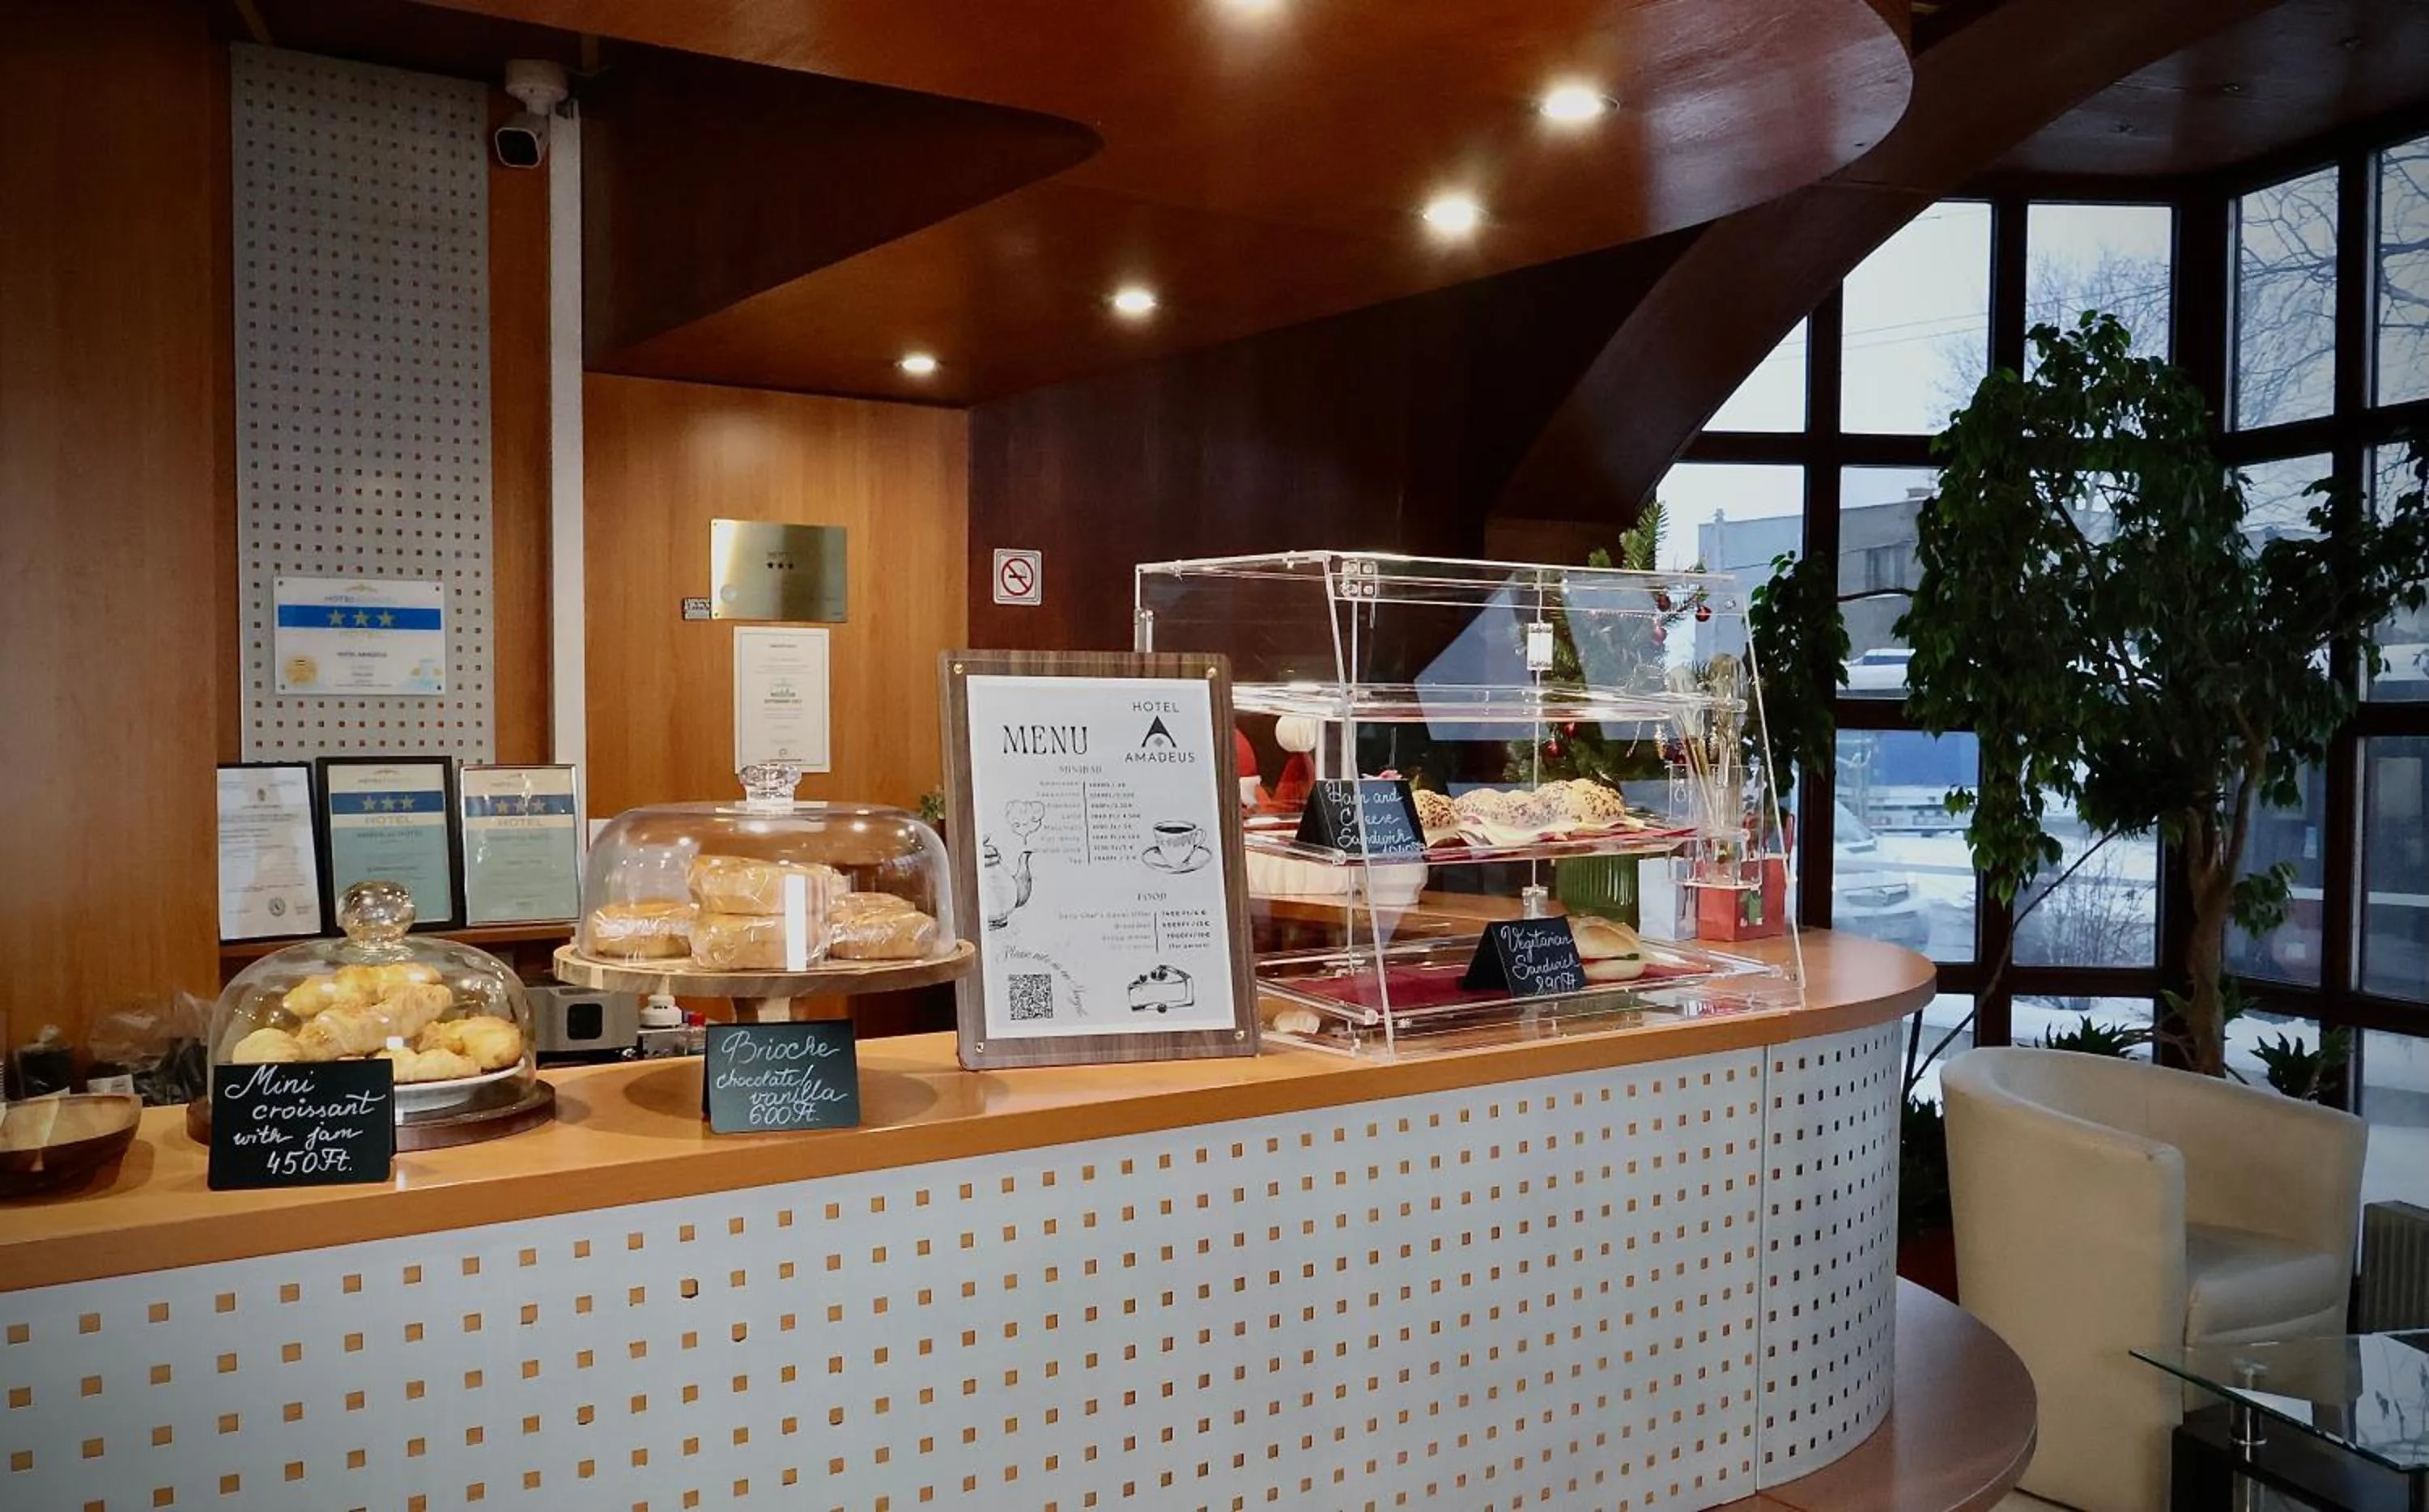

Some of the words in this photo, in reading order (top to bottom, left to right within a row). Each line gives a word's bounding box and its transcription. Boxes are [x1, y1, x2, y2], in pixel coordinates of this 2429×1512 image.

[1133, 702, 1180, 713] HOTEL
[1002, 725, 1088, 755] MENU
[1125, 752, 1196, 763] AMADEUS
[1373, 787, 1404, 804] and
[1340, 808, 1400, 826] Ceese
[721, 1030, 840, 1064] Brioche
[224, 1064, 315, 1099] Mini
[749, 1080, 849, 1106] vanilla
[252, 1089, 387, 1120] croissant
[232, 1124, 294, 1145] with
[304, 1121, 364, 1150] jam
